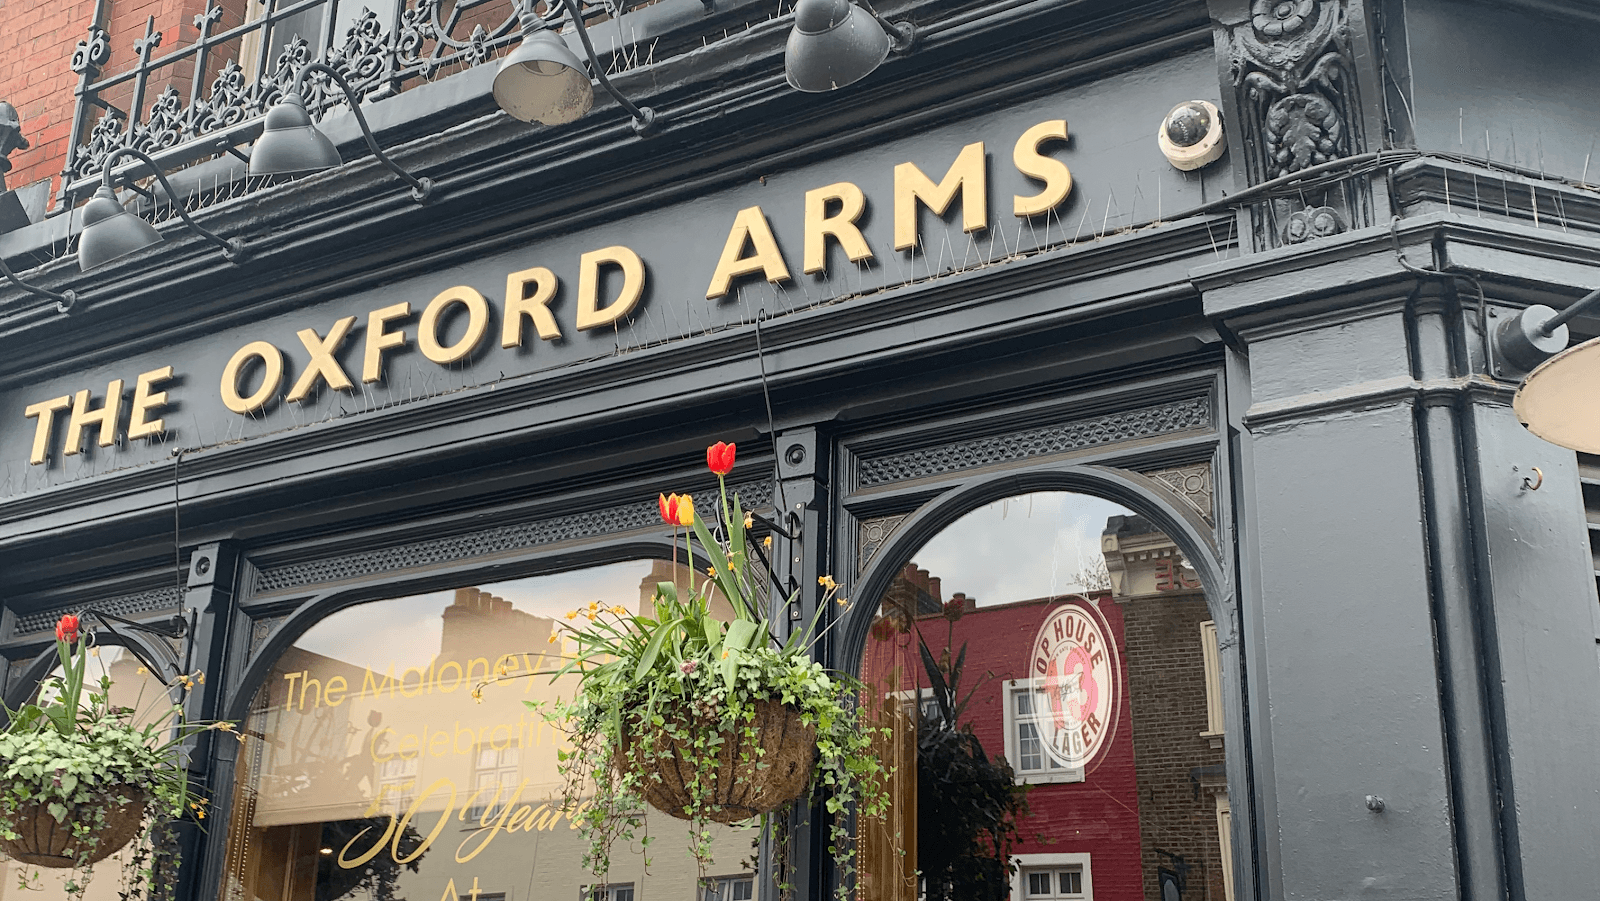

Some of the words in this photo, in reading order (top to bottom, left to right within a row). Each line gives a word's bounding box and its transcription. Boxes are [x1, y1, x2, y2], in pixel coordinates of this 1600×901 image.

[24, 365, 175, 466] THE
[219, 245, 647, 415] OXFORD
[705, 119, 1074, 300] ARMS
[1053, 615, 1104, 671] HOUSE
[284, 669, 348, 712] The
[360, 648, 547, 702] Maloney
[1041, 645, 1099, 730] 13
[1053, 711, 1101, 756] LAGER
[337, 776, 457, 870] 50
[455, 777, 595, 864] Years
[439, 877, 483, 901] At
